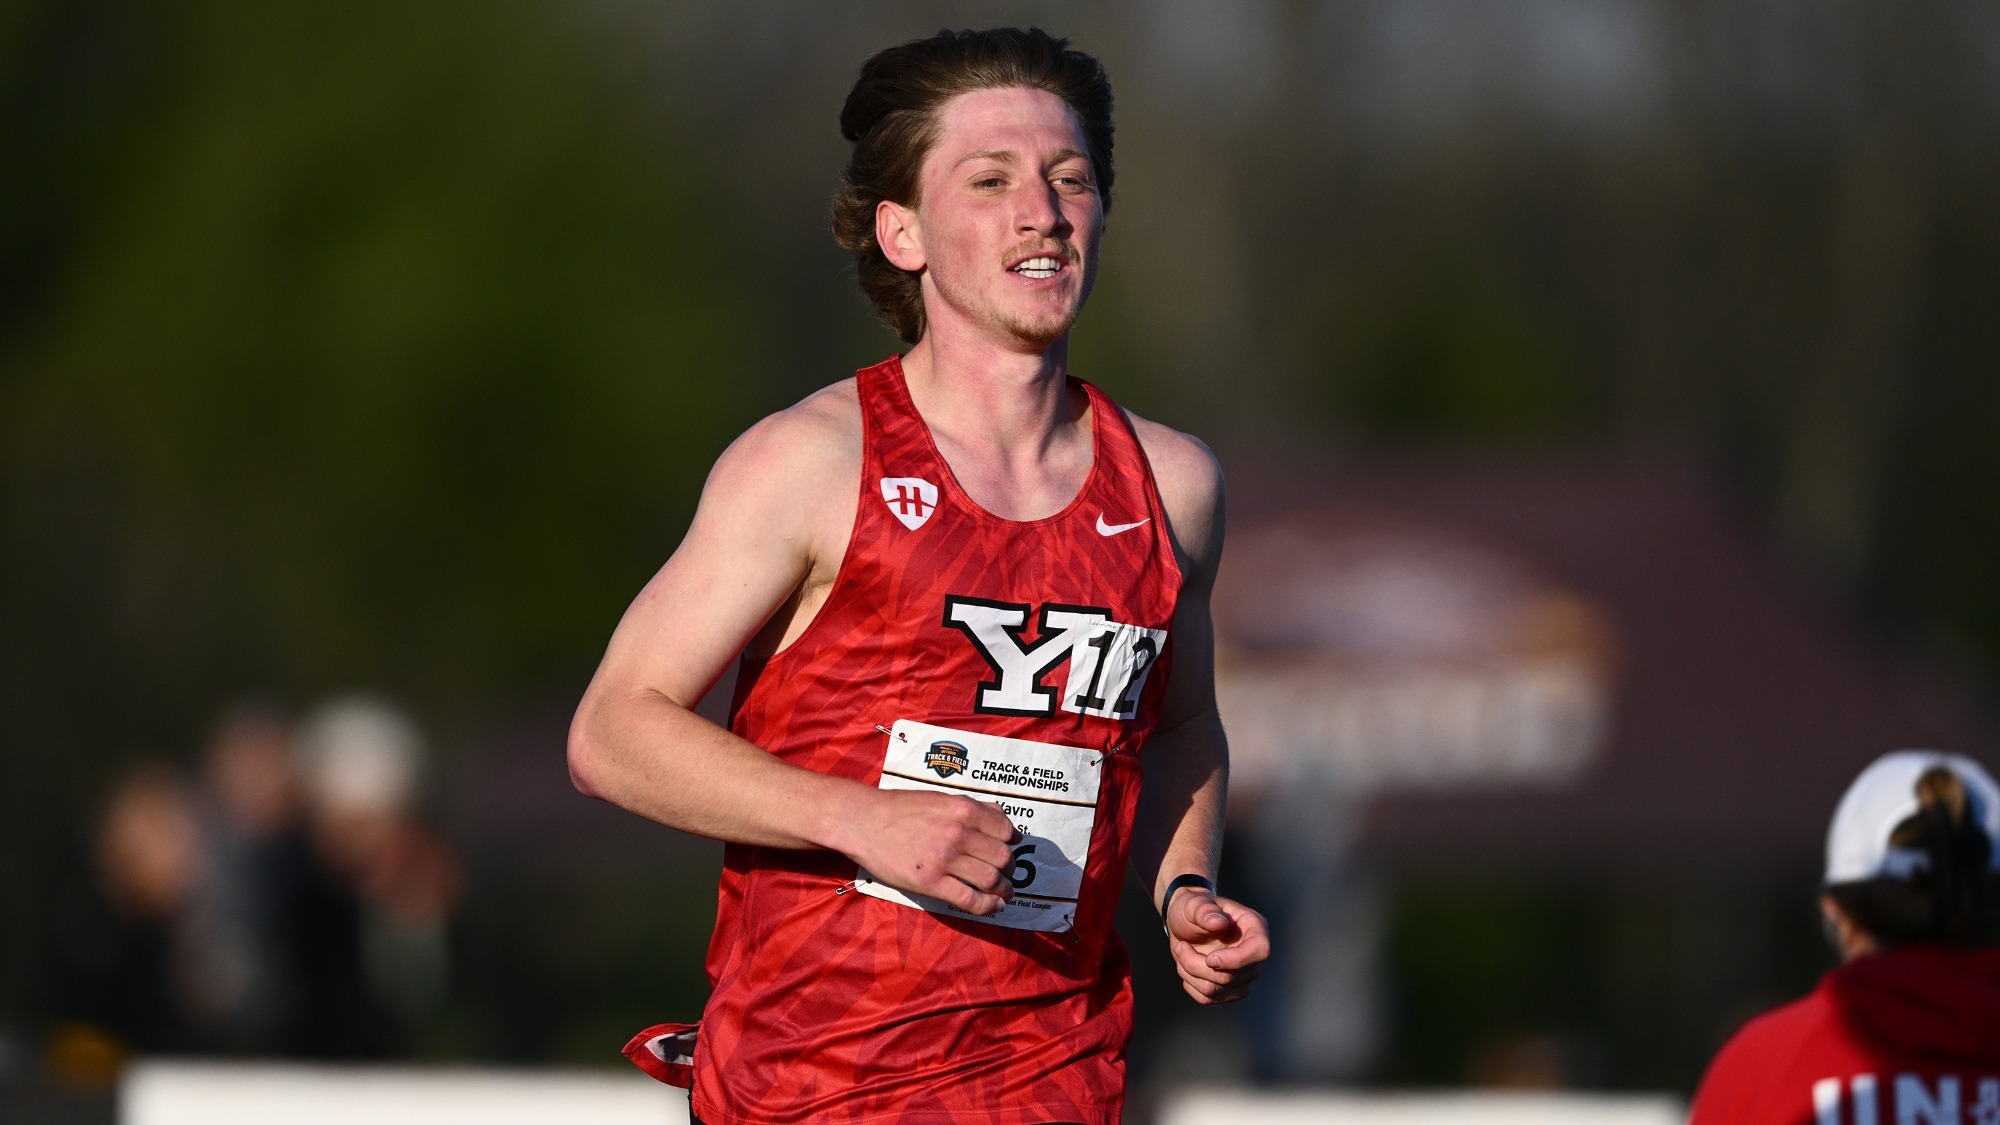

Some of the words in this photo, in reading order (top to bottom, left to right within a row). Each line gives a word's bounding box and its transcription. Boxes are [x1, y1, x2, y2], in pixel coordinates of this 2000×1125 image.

[942, 594, 1113, 718] Y
[1074, 630, 1157, 714] 12
[927, 753, 946, 761] TRACK
[951, 756, 967, 767] FIELD
[982, 760, 1020, 774] TRACK
[1022, 766, 1030, 776] &
[1032, 767, 1064, 780] FIELD
[971, 769, 1069, 793] CHAMPIONSHIPS
[1017, 900, 1031, 908] Field
